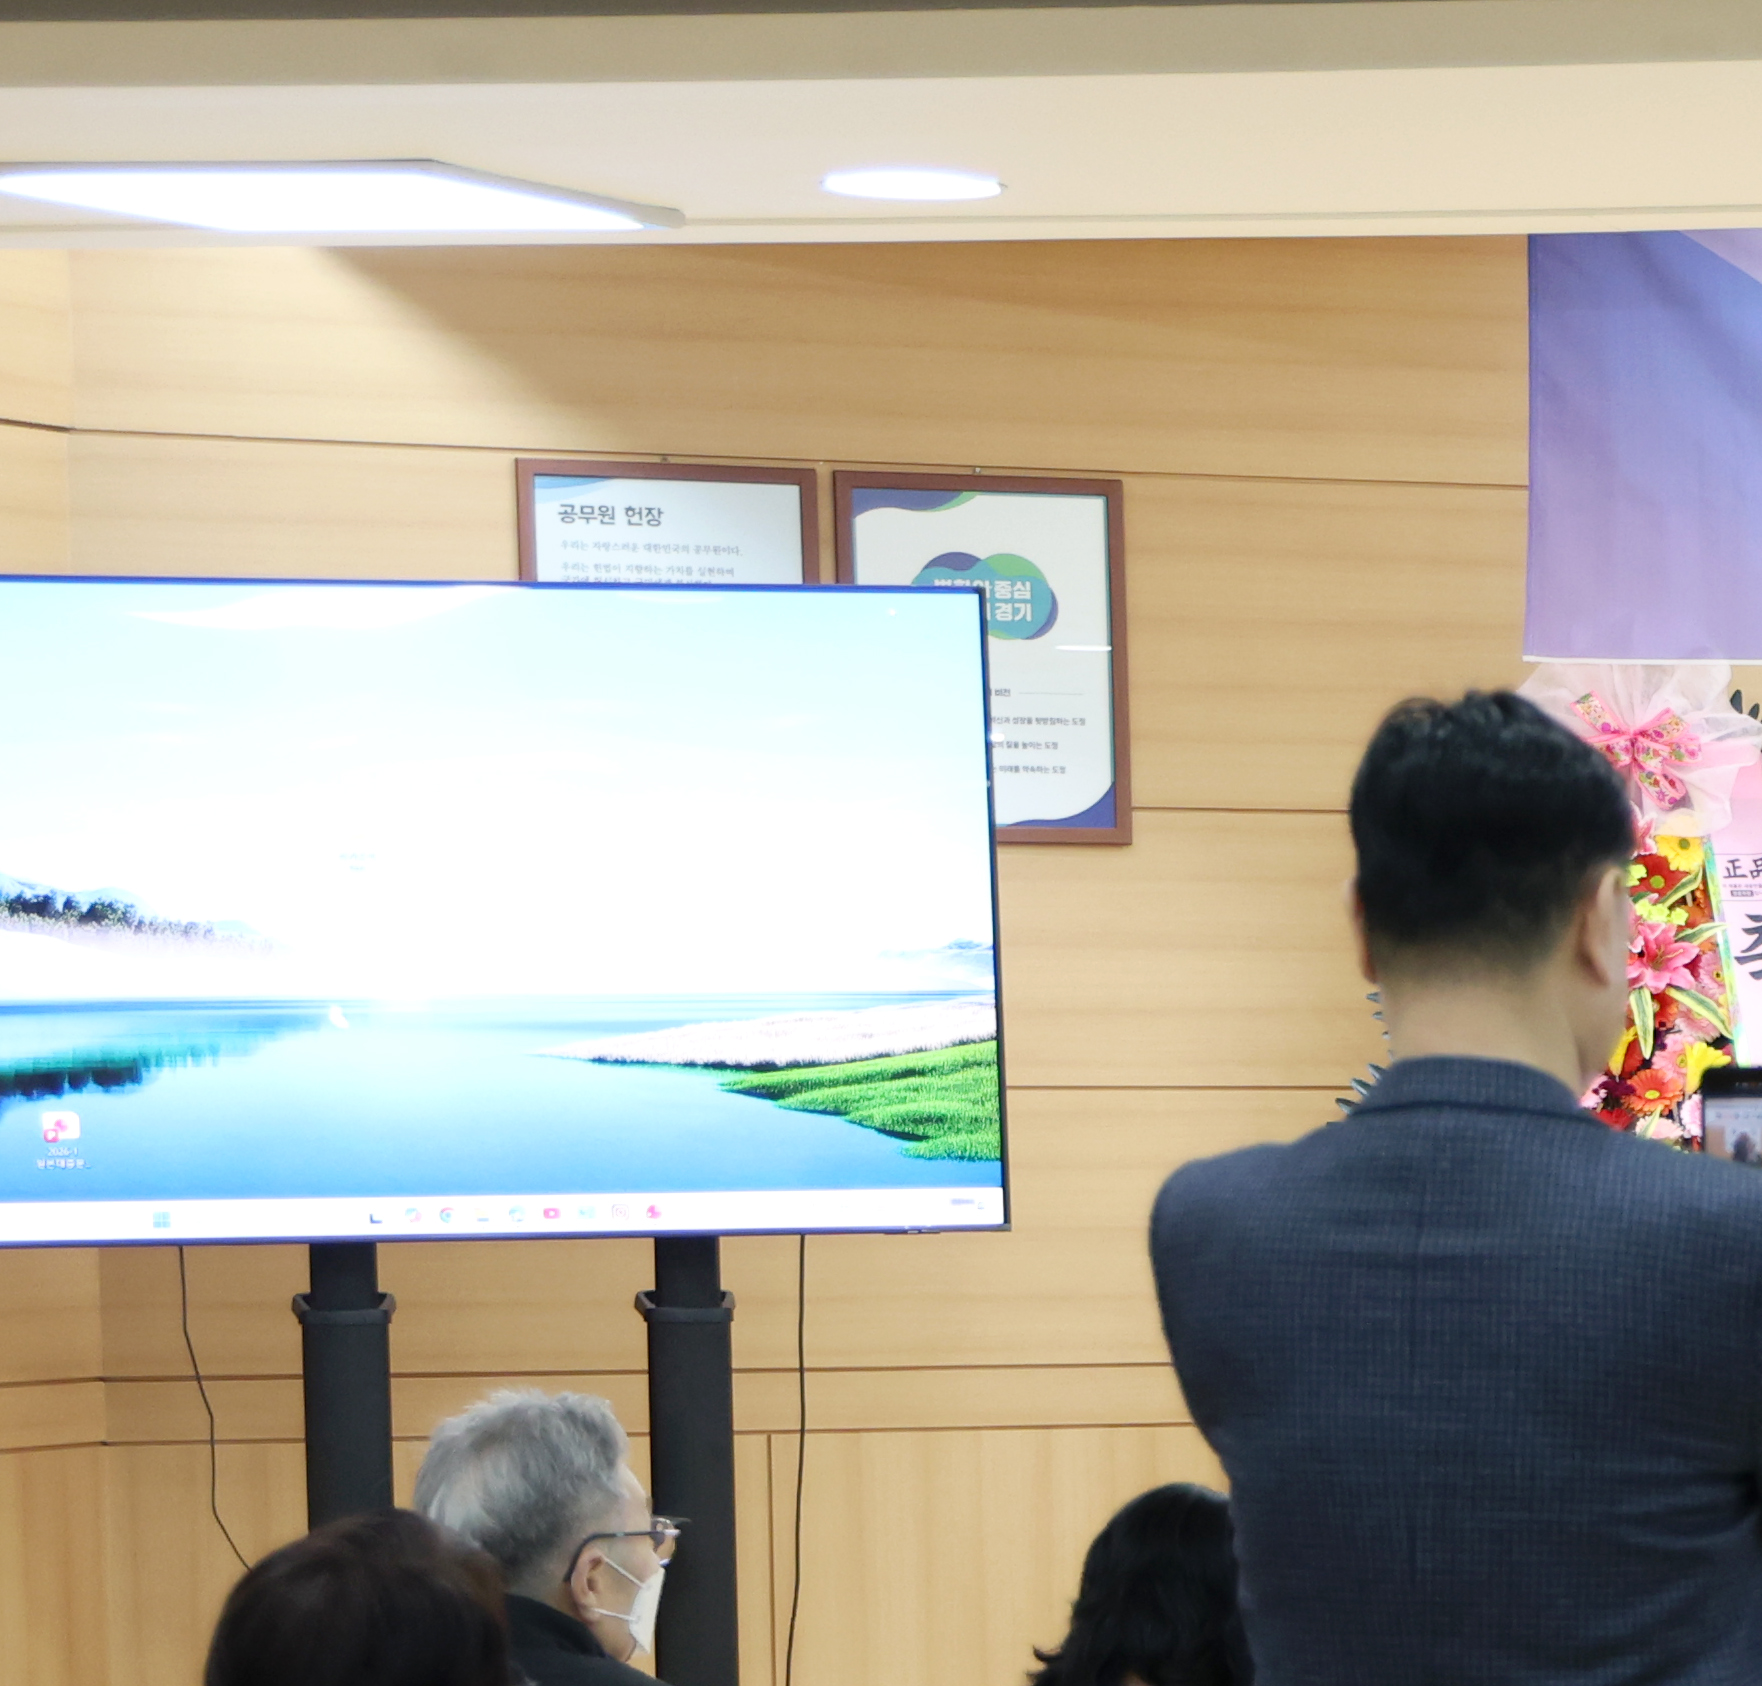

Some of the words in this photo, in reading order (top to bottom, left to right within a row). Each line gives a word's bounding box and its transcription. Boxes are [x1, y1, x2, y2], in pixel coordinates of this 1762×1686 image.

[558, 503, 616, 525] 공무원
[624, 506, 664, 527] 헌장
[994, 580, 1032, 599] 중심
[994, 603, 1033, 622] 경기
